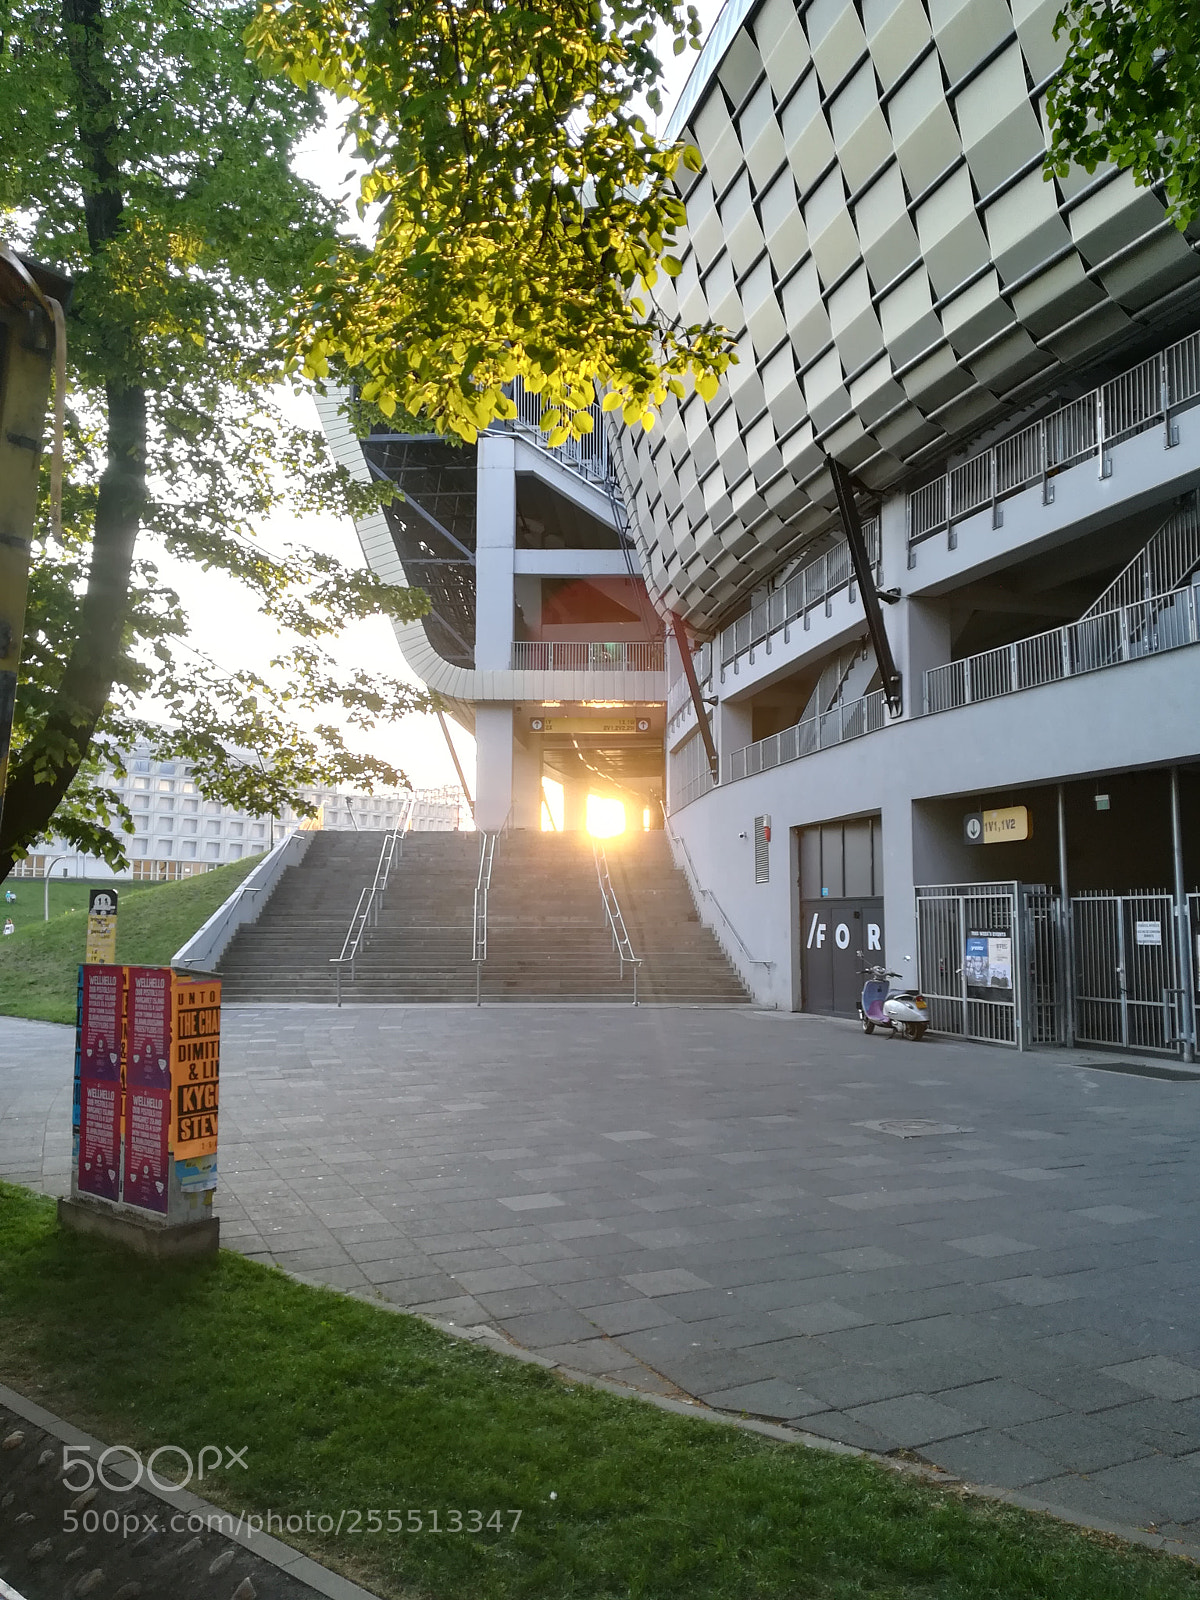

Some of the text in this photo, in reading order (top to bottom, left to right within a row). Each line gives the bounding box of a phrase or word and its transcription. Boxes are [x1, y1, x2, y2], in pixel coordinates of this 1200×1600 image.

[178, 990, 216, 1005] UNTO
[178, 1011, 197, 1037] THE
[188, 1063, 199, 1080] &
